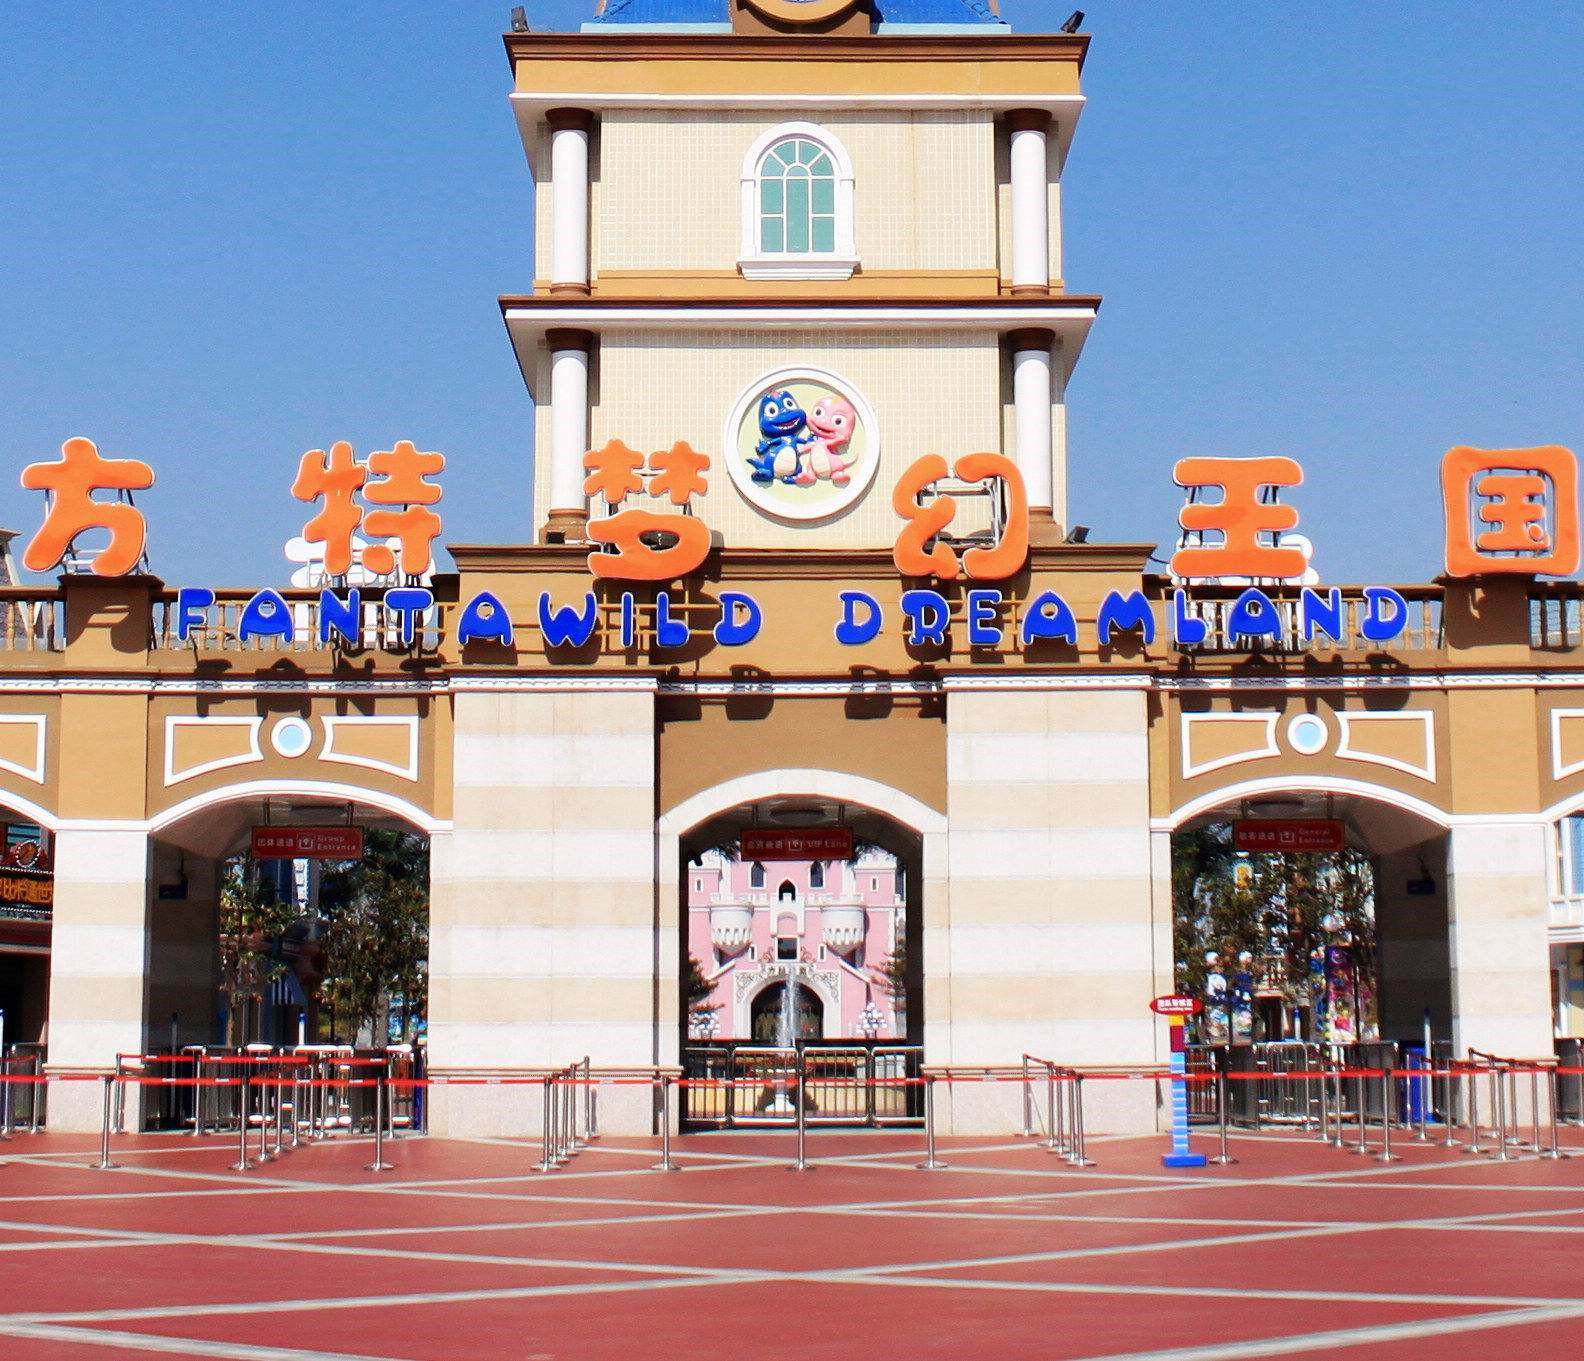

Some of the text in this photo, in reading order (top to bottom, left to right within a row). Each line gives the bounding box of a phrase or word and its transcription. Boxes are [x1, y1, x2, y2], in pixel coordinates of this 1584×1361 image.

[21, 436, 1582, 581] 方特梦幻王国
[177, 587, 1410, 647] FANTAWILD DREAMLAND
